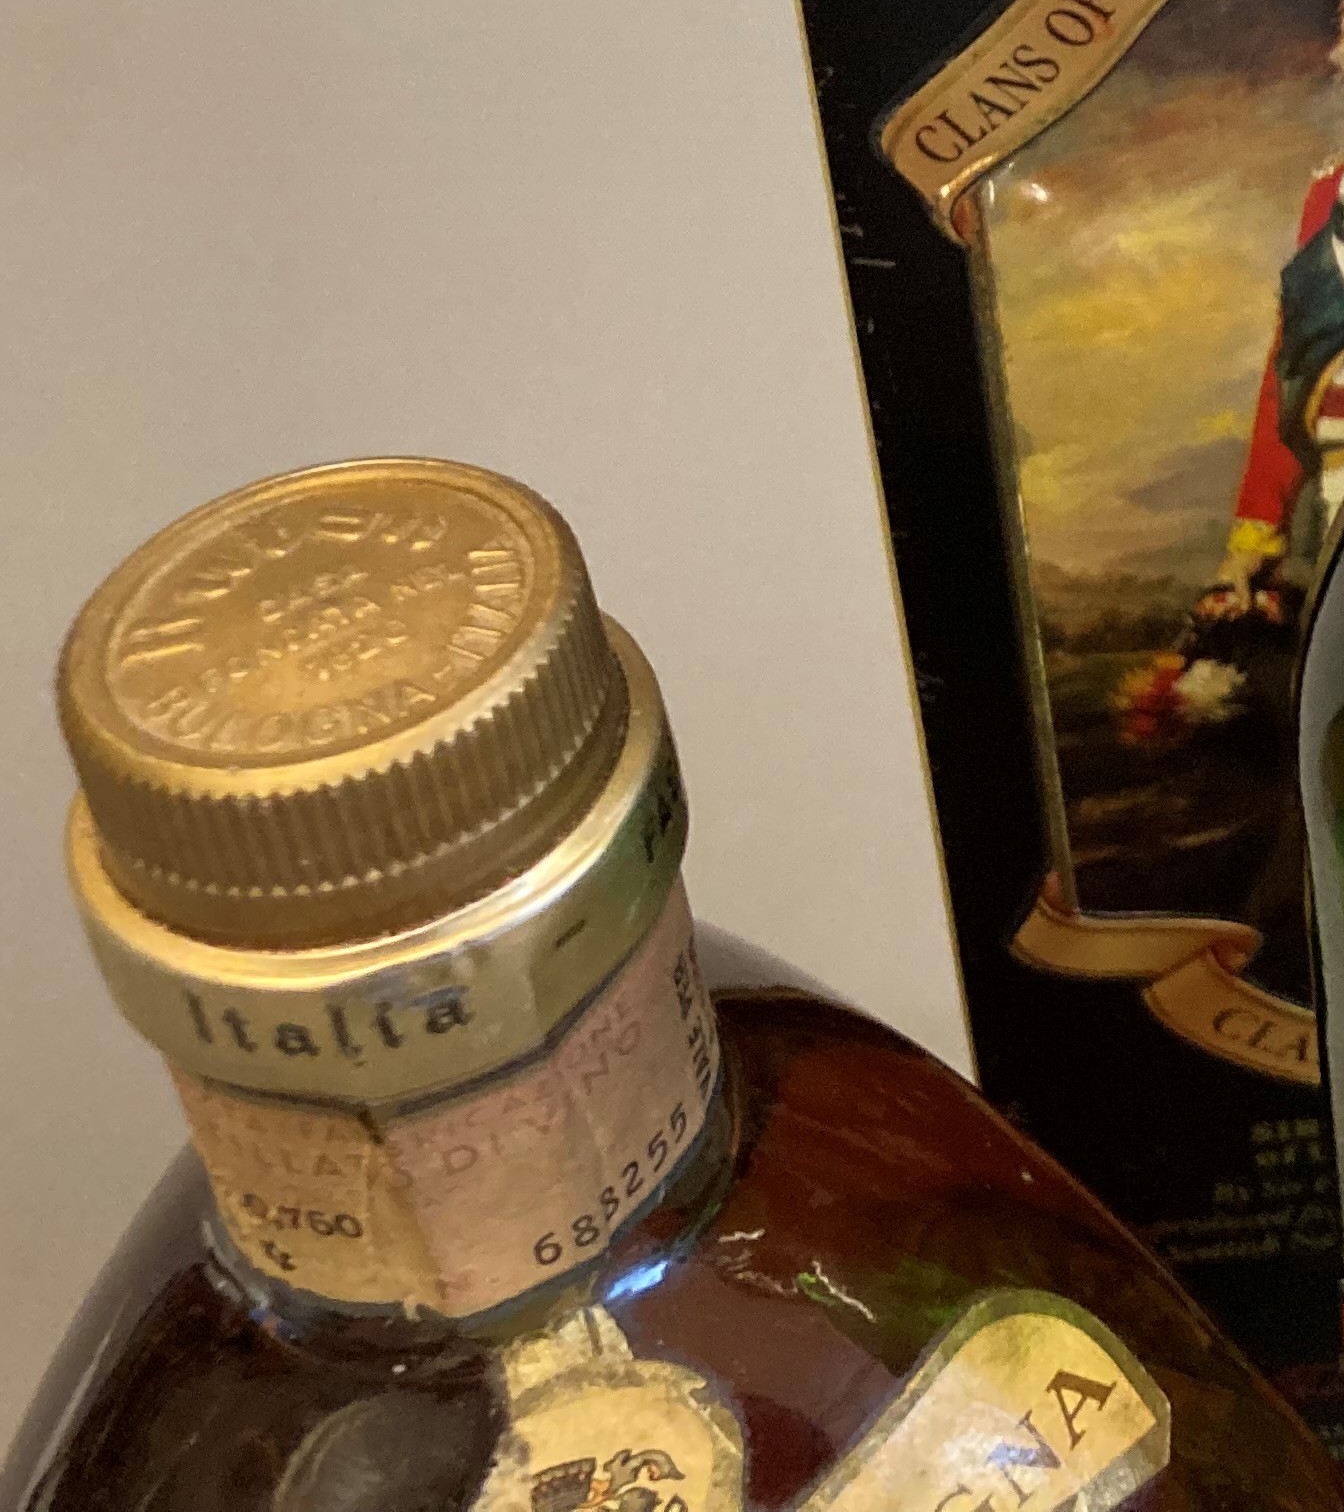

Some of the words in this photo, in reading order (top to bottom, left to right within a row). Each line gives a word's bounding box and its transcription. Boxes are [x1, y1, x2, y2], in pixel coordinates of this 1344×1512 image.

[914, 42, 1062, 165] CLANS
[183, 990, 475, 1059] Italia
[1211, 1006, 1309, 1065] CLA
